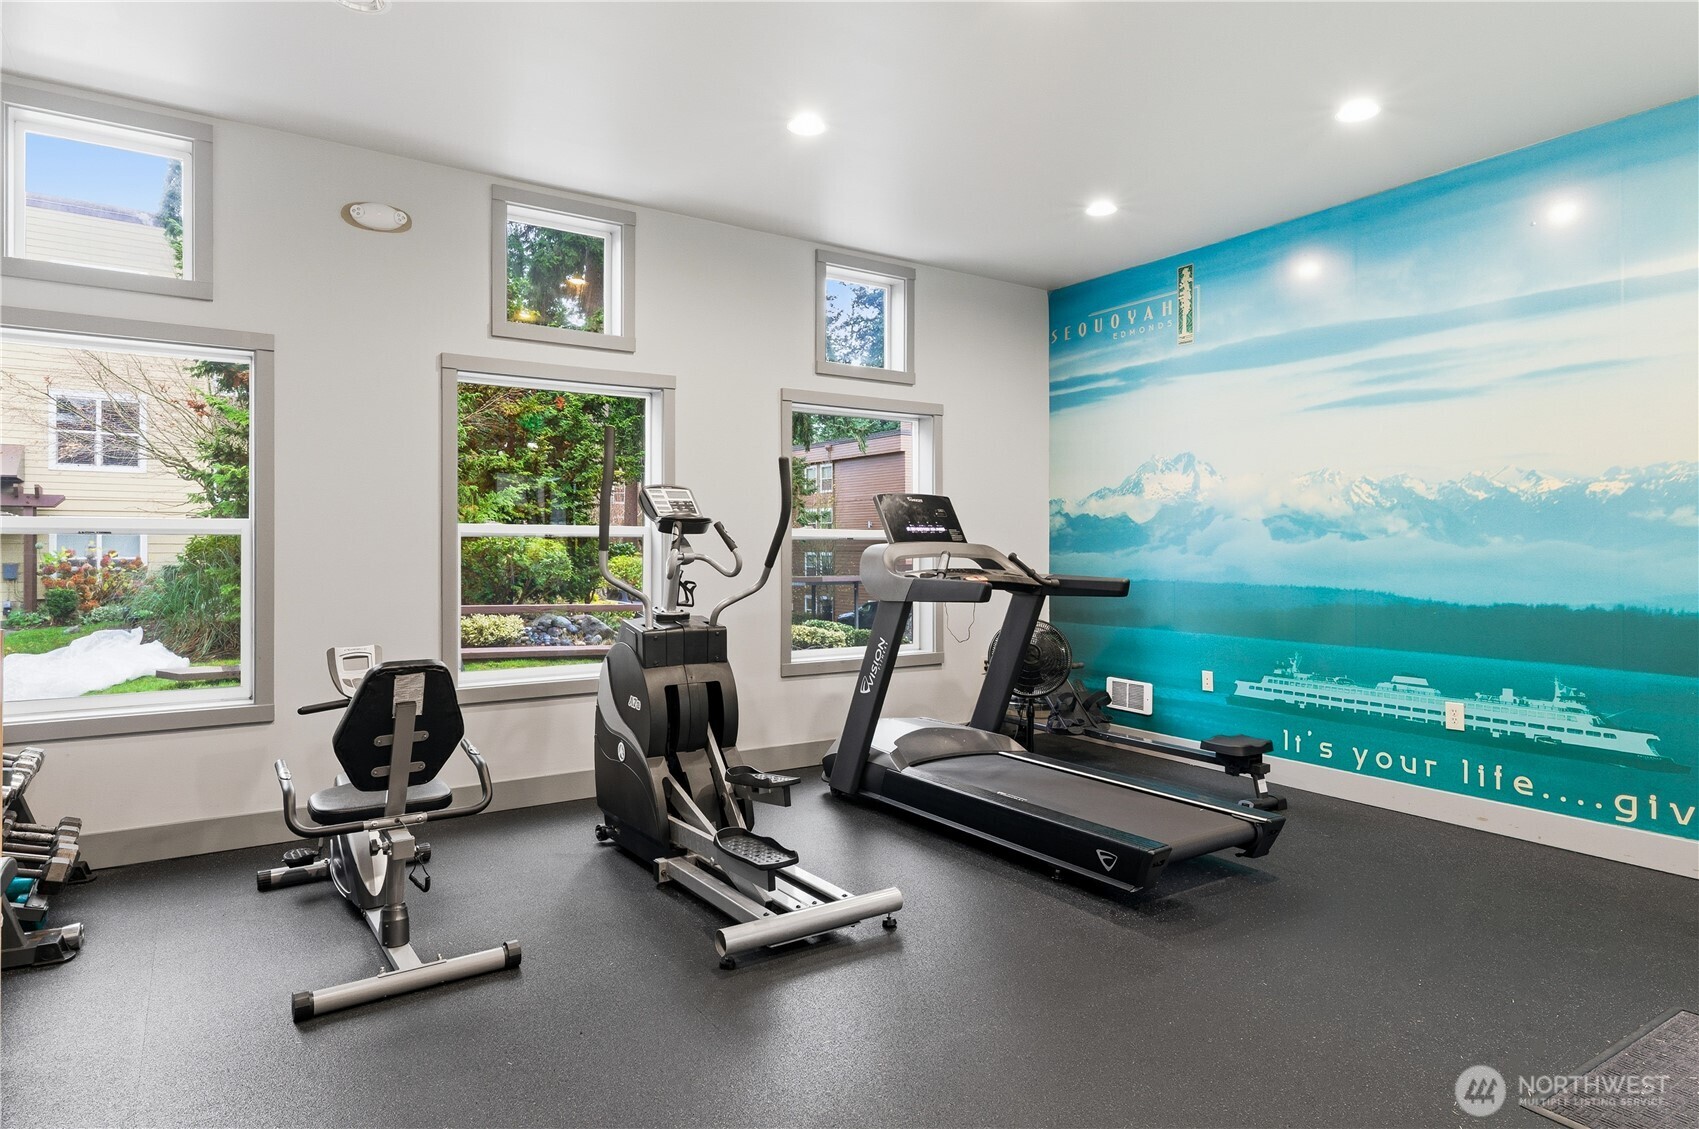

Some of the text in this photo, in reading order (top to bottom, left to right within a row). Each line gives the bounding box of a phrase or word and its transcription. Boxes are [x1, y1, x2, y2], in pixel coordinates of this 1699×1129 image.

[1051, 299, 1173, 344] SEQUOYAH
[1112, 319, 1173, 340] EDMONDS
[867, 636, 886, 686] VISION
[1283, 729, 1333, 759] It's
[1352, 746, 1437, 777] your
